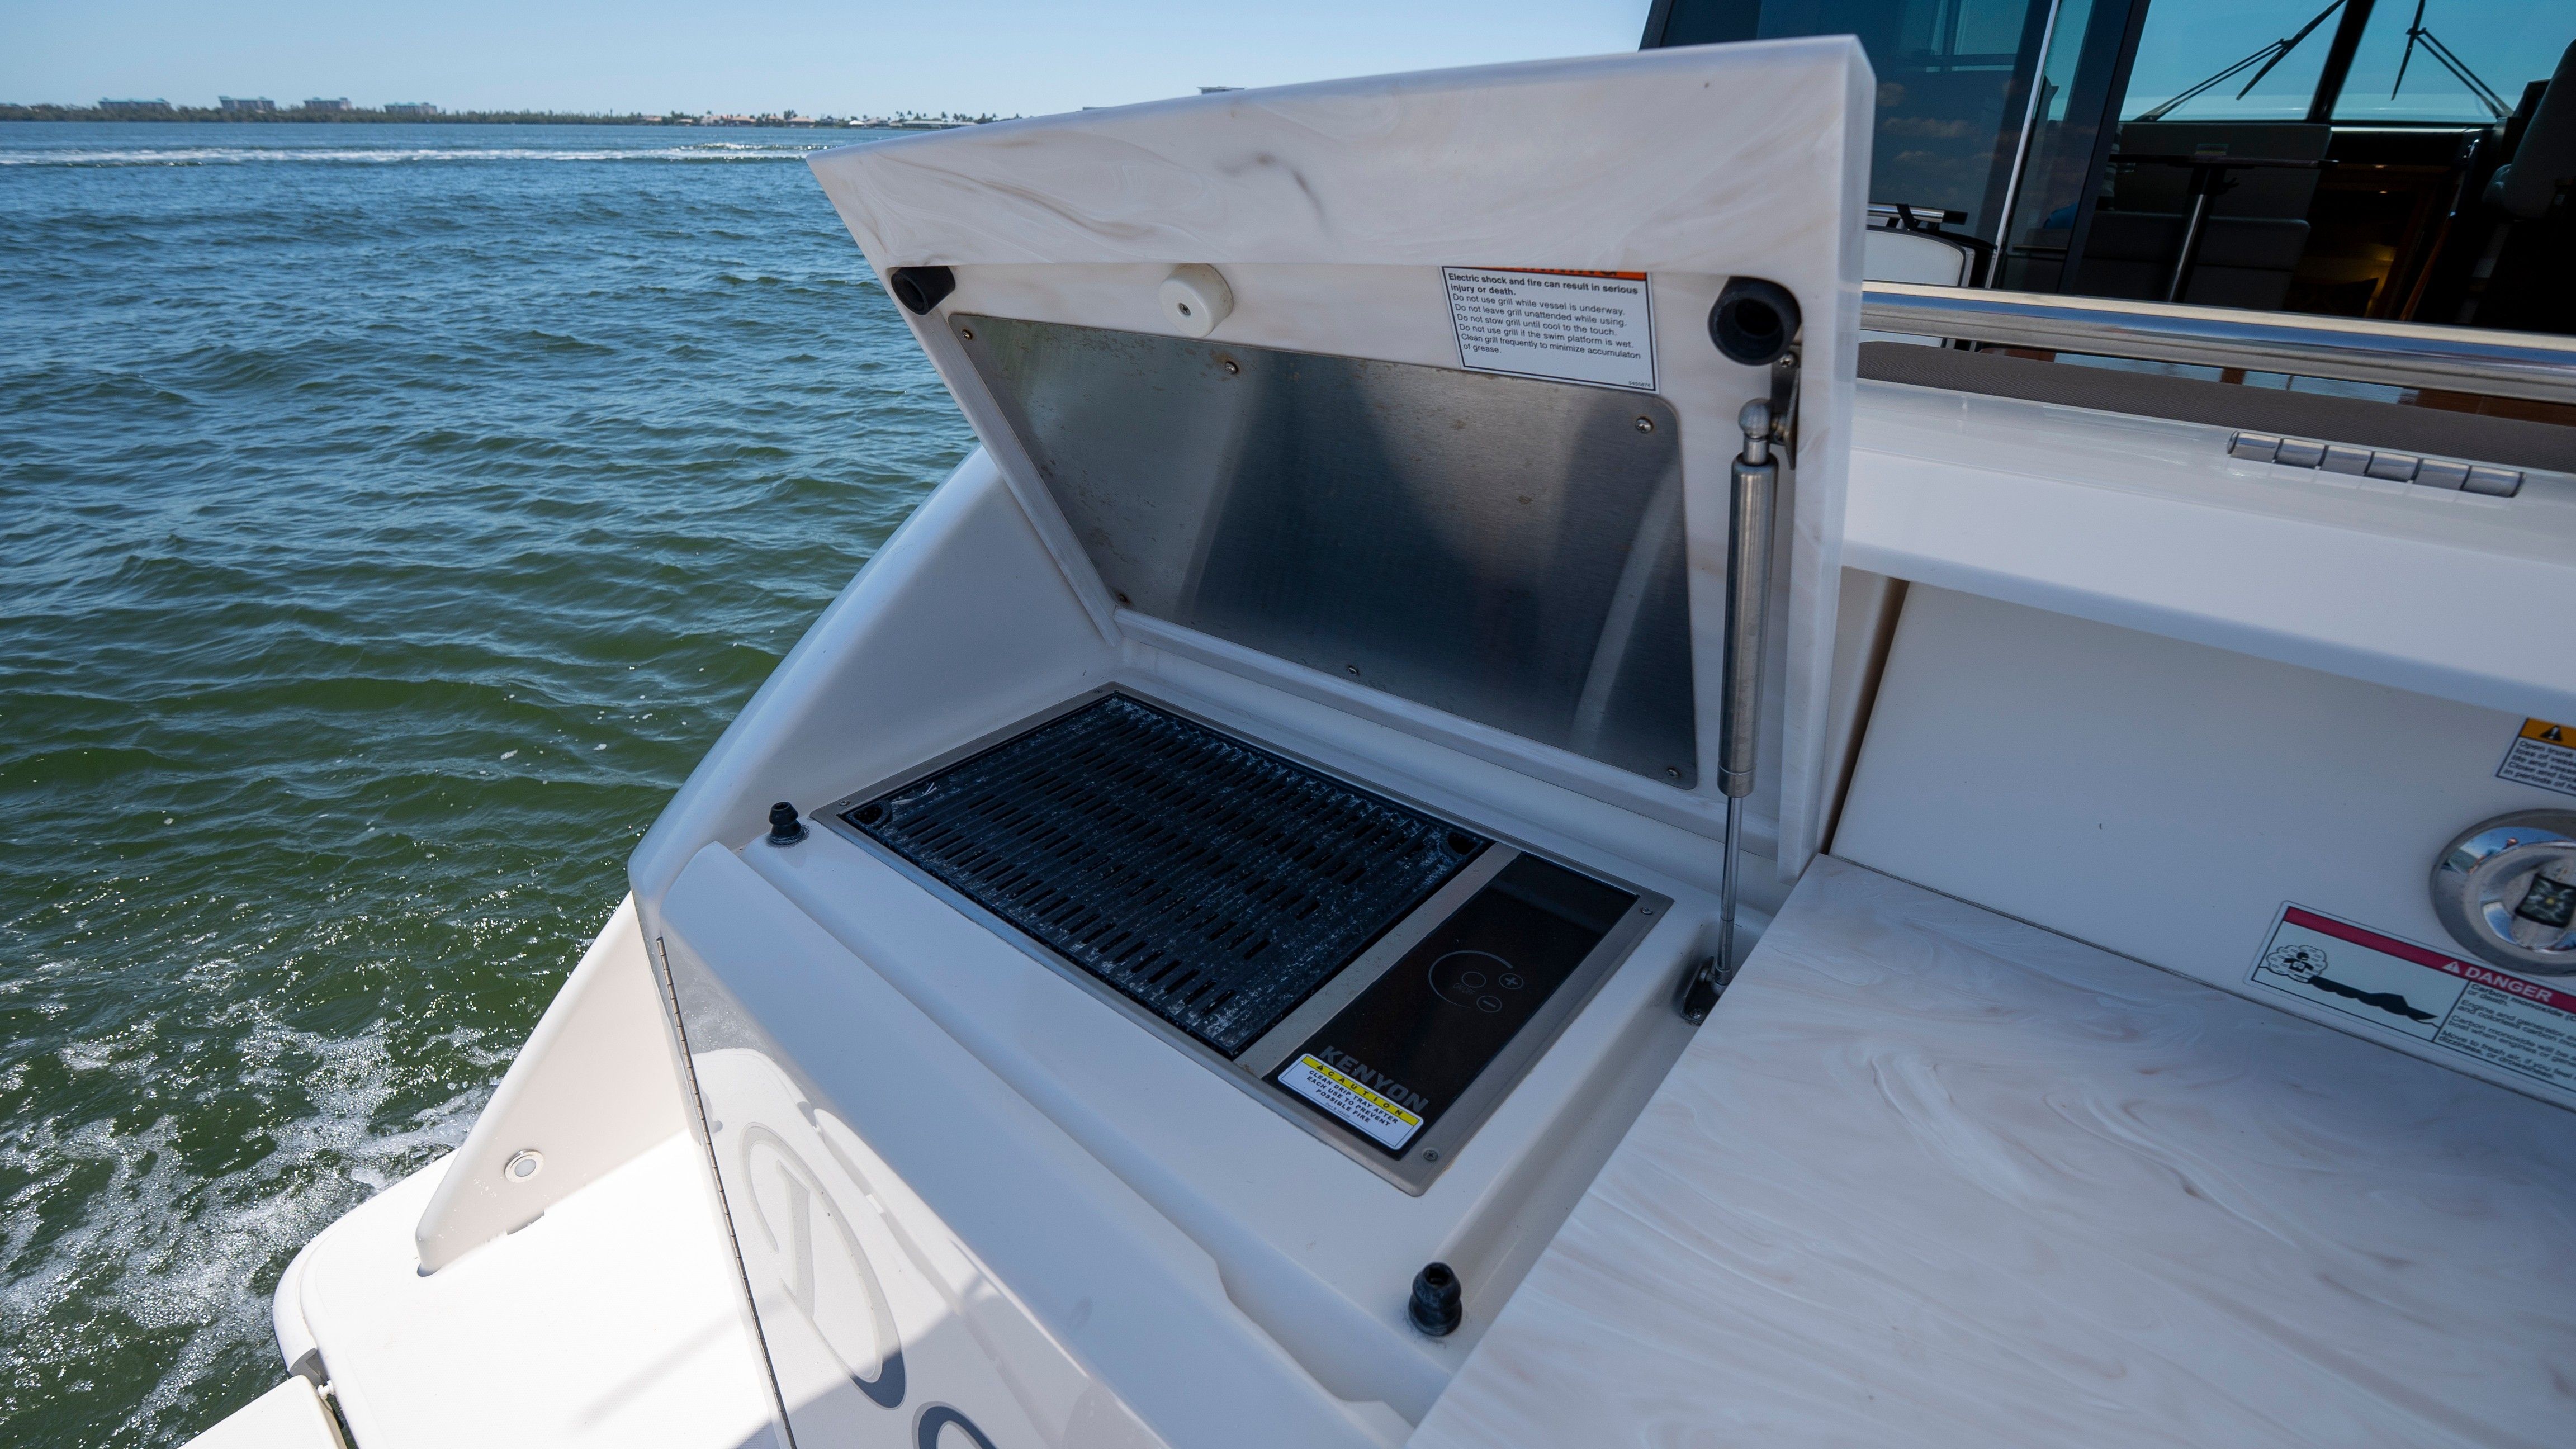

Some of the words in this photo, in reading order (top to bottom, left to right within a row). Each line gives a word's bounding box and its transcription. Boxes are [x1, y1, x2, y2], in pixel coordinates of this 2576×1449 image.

[1448, 273, 1479, 282] Electric
[1481, 276, 1507, 284] shock
[1563, 282, 1589, 291] result
[1603, 285, 1638, 295] serious
[1451, 284, 1474, 294] injury
[1489, 287, 1516, 295] death.
[1483, 306, 1504, 315] leave
[1507, 309, 1522, 317] grill
[1524, 310, 1571, 321] unattended
[1600, 318, 1627, 328] using.
[1539, 302, 1567, 310] vessel
[1579, 305, 1625, 316] underway.
[1505, 318, 1521, 326] grill
[1590, 326, 1617, 336] touch.
[1461, 333, 1483, 342] Clean
[1485, 336, 1498, 344] grill
[1499, 338, 1537, 349] frequently
[1550, 344, 1585, 353] minimize
[1473, 344, 1502, 353] grease.
[1503, 328, 1518, 337] grill
[1527, 330, 1541, 339] the
[1543, 333, 1565, 341] swim
[1568, 335, 1603, 345] platform
[1615, 339, 1633, 348] wet.
[2464, 967, 2553, 1002] DANGER
[2471, 984, 2509, 1000] Carbon
[2457, 1006, 2477, 1015] and
[2461, 999, 2494, 1014] Engine
[2496, 1012, 2516, 1021] and
[2451, 1015, 2487, 1030] Carbon
[1319, 1045, 1429, 1112] KENYON
[1307, 1076, 1327, 1089] EACH
[1328, 1088, 1343, 1098] USE
[1356, 1104, 1390, 1126] PREVENT
[1309, 1070, 1333, 1085] CLEAN
[1333, 1085, 1352, 1095] DRIP
[1353, 1095, 1372, 1108] TRAY
[1373, 1107, 1398, 1124] AFTER
[1328, 1071, 1403, 1116] CAUTION
[1316, 1088, 1352, 1111] POSSIBLE
[1353, 1110, 1371, 1123] FIRE
